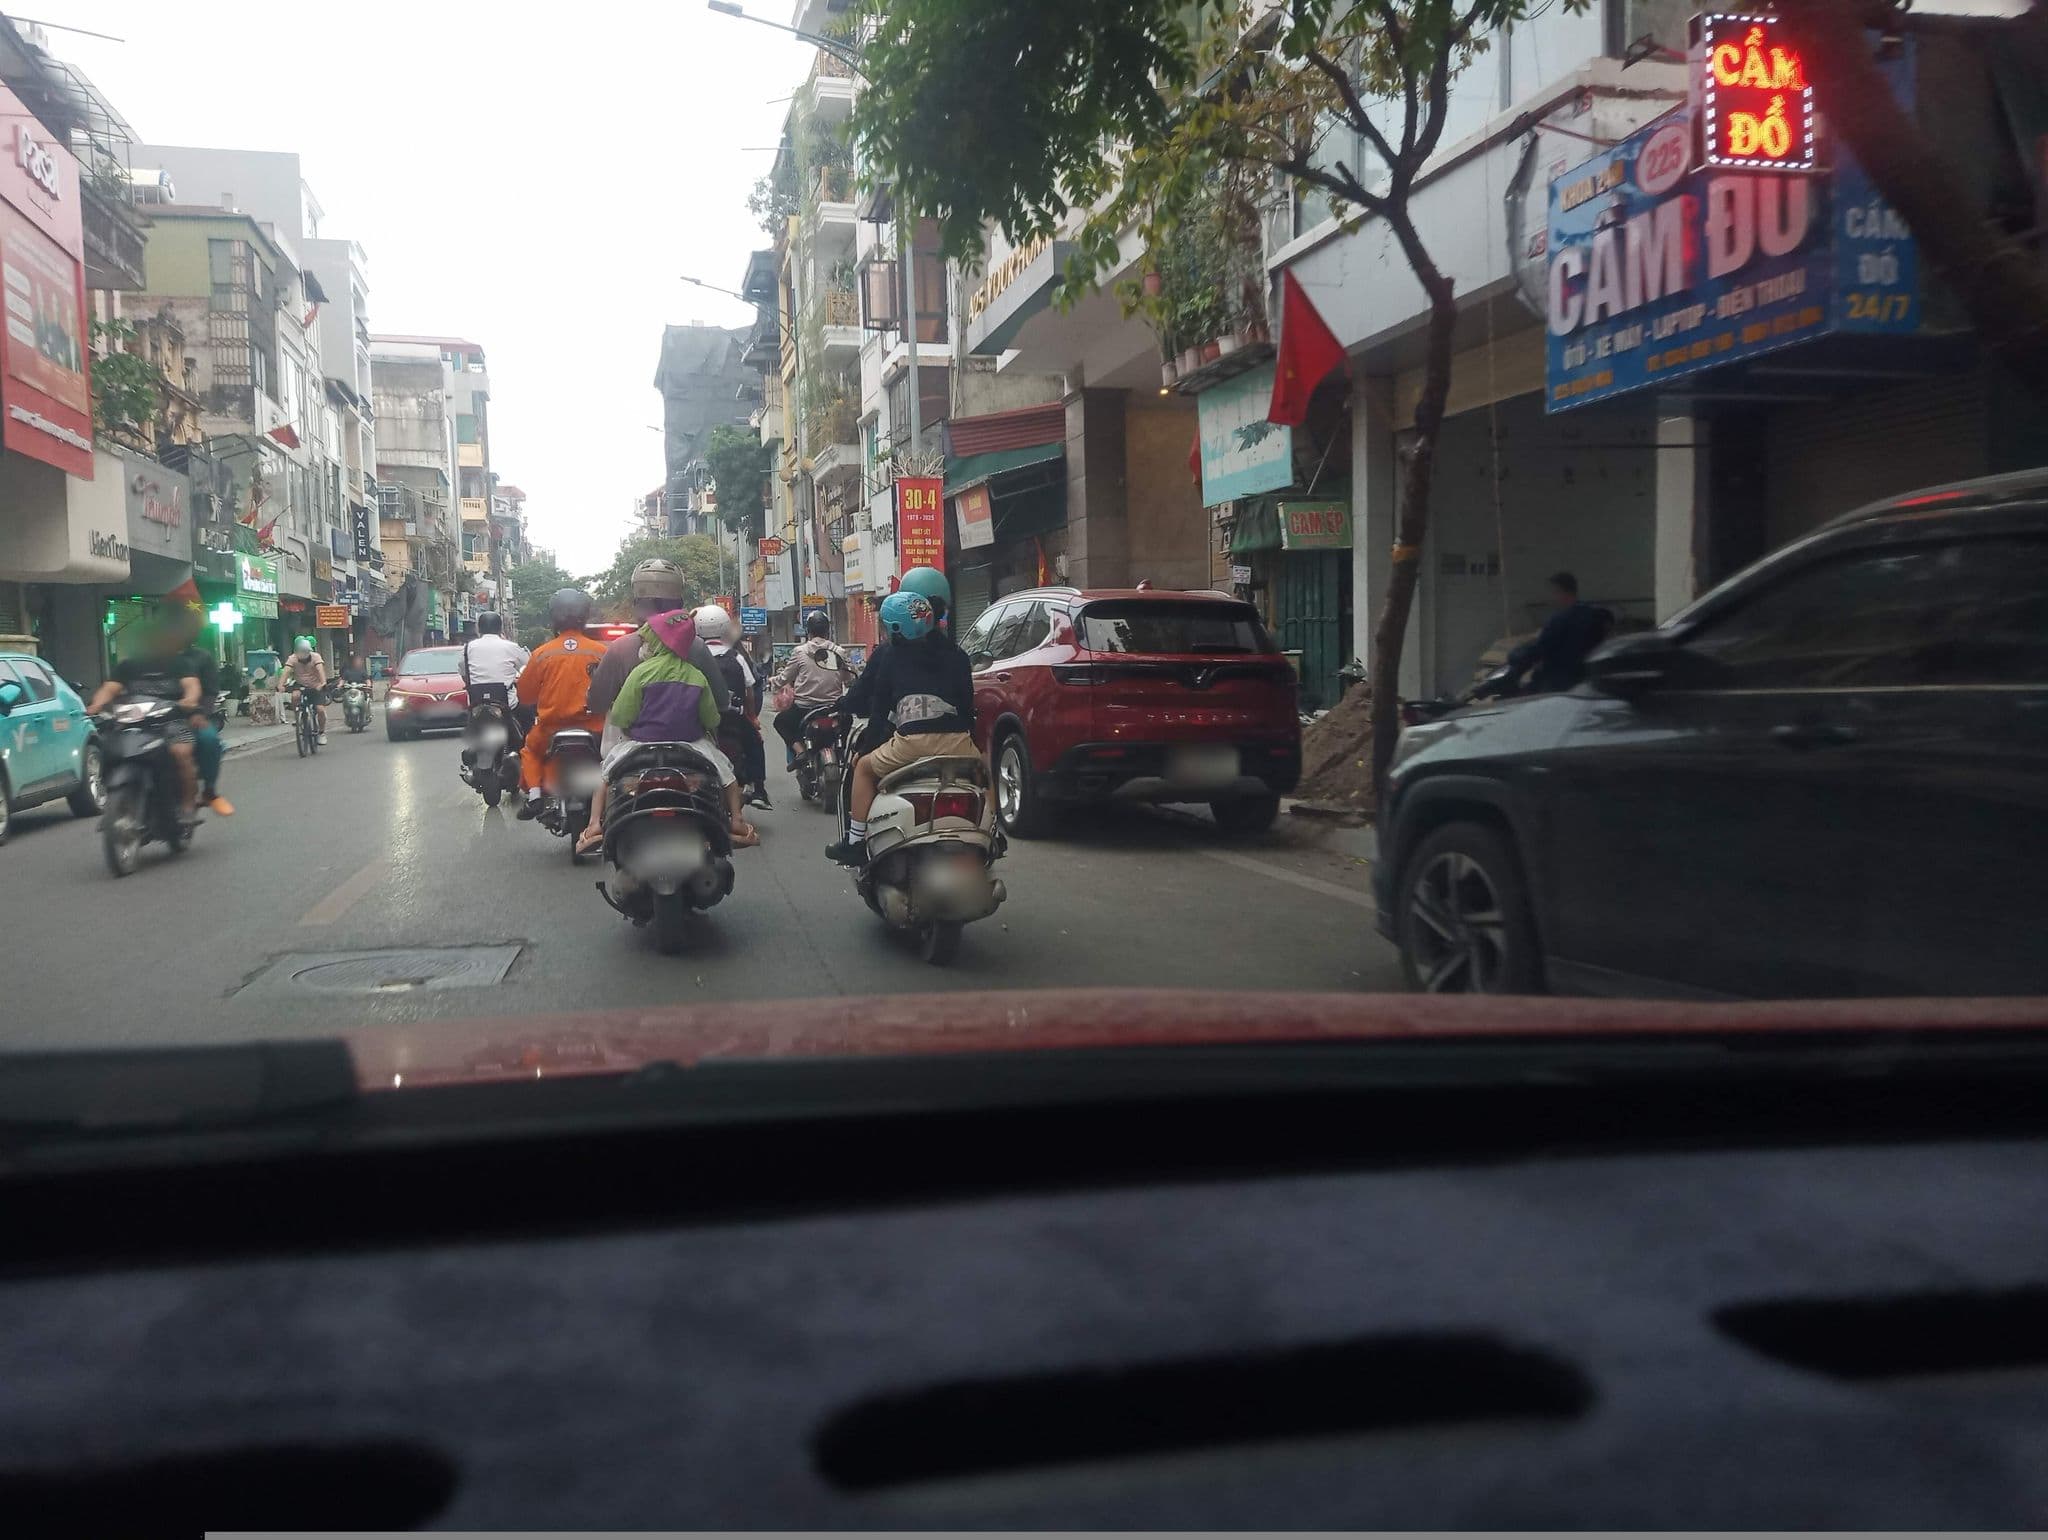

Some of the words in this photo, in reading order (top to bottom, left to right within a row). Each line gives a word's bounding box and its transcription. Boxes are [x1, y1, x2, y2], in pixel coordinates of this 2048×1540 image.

[1646, 135, 1682, 182] 225
[986, 252, 1014, 304] YOUR
[1846, 292, 1910, 322] 24/7
[356, 511, 368, 556] VALEN
[925, 538, 932, 546] 50
